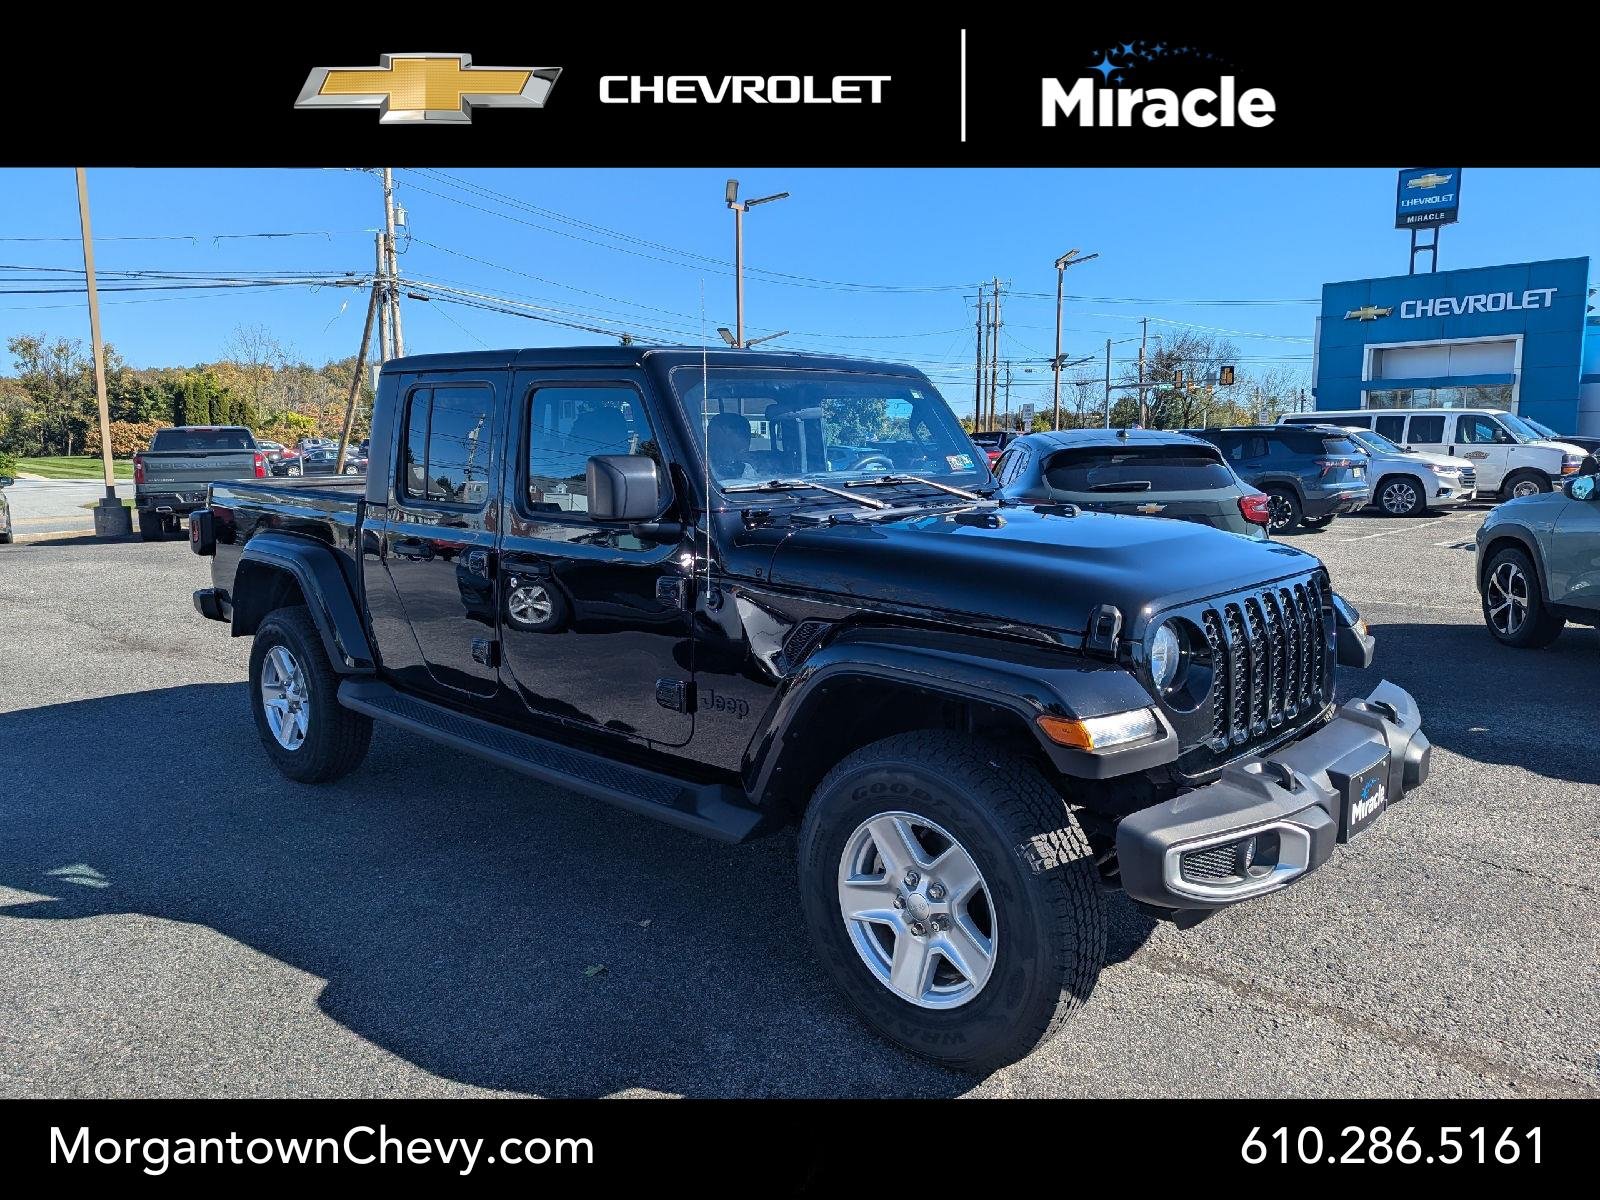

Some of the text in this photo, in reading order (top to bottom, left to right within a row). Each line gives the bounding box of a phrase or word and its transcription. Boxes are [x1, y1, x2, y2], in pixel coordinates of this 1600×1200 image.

[1401, 193, 1454, 207] CHEVROLET
[1407, 212, 1445, 223] MIRACLE
[1400, 287, 1558, 319] CHEVROLET
[700, 688, 750, 720] Jeep
[1351, 783, 1385, 826] Miracle
